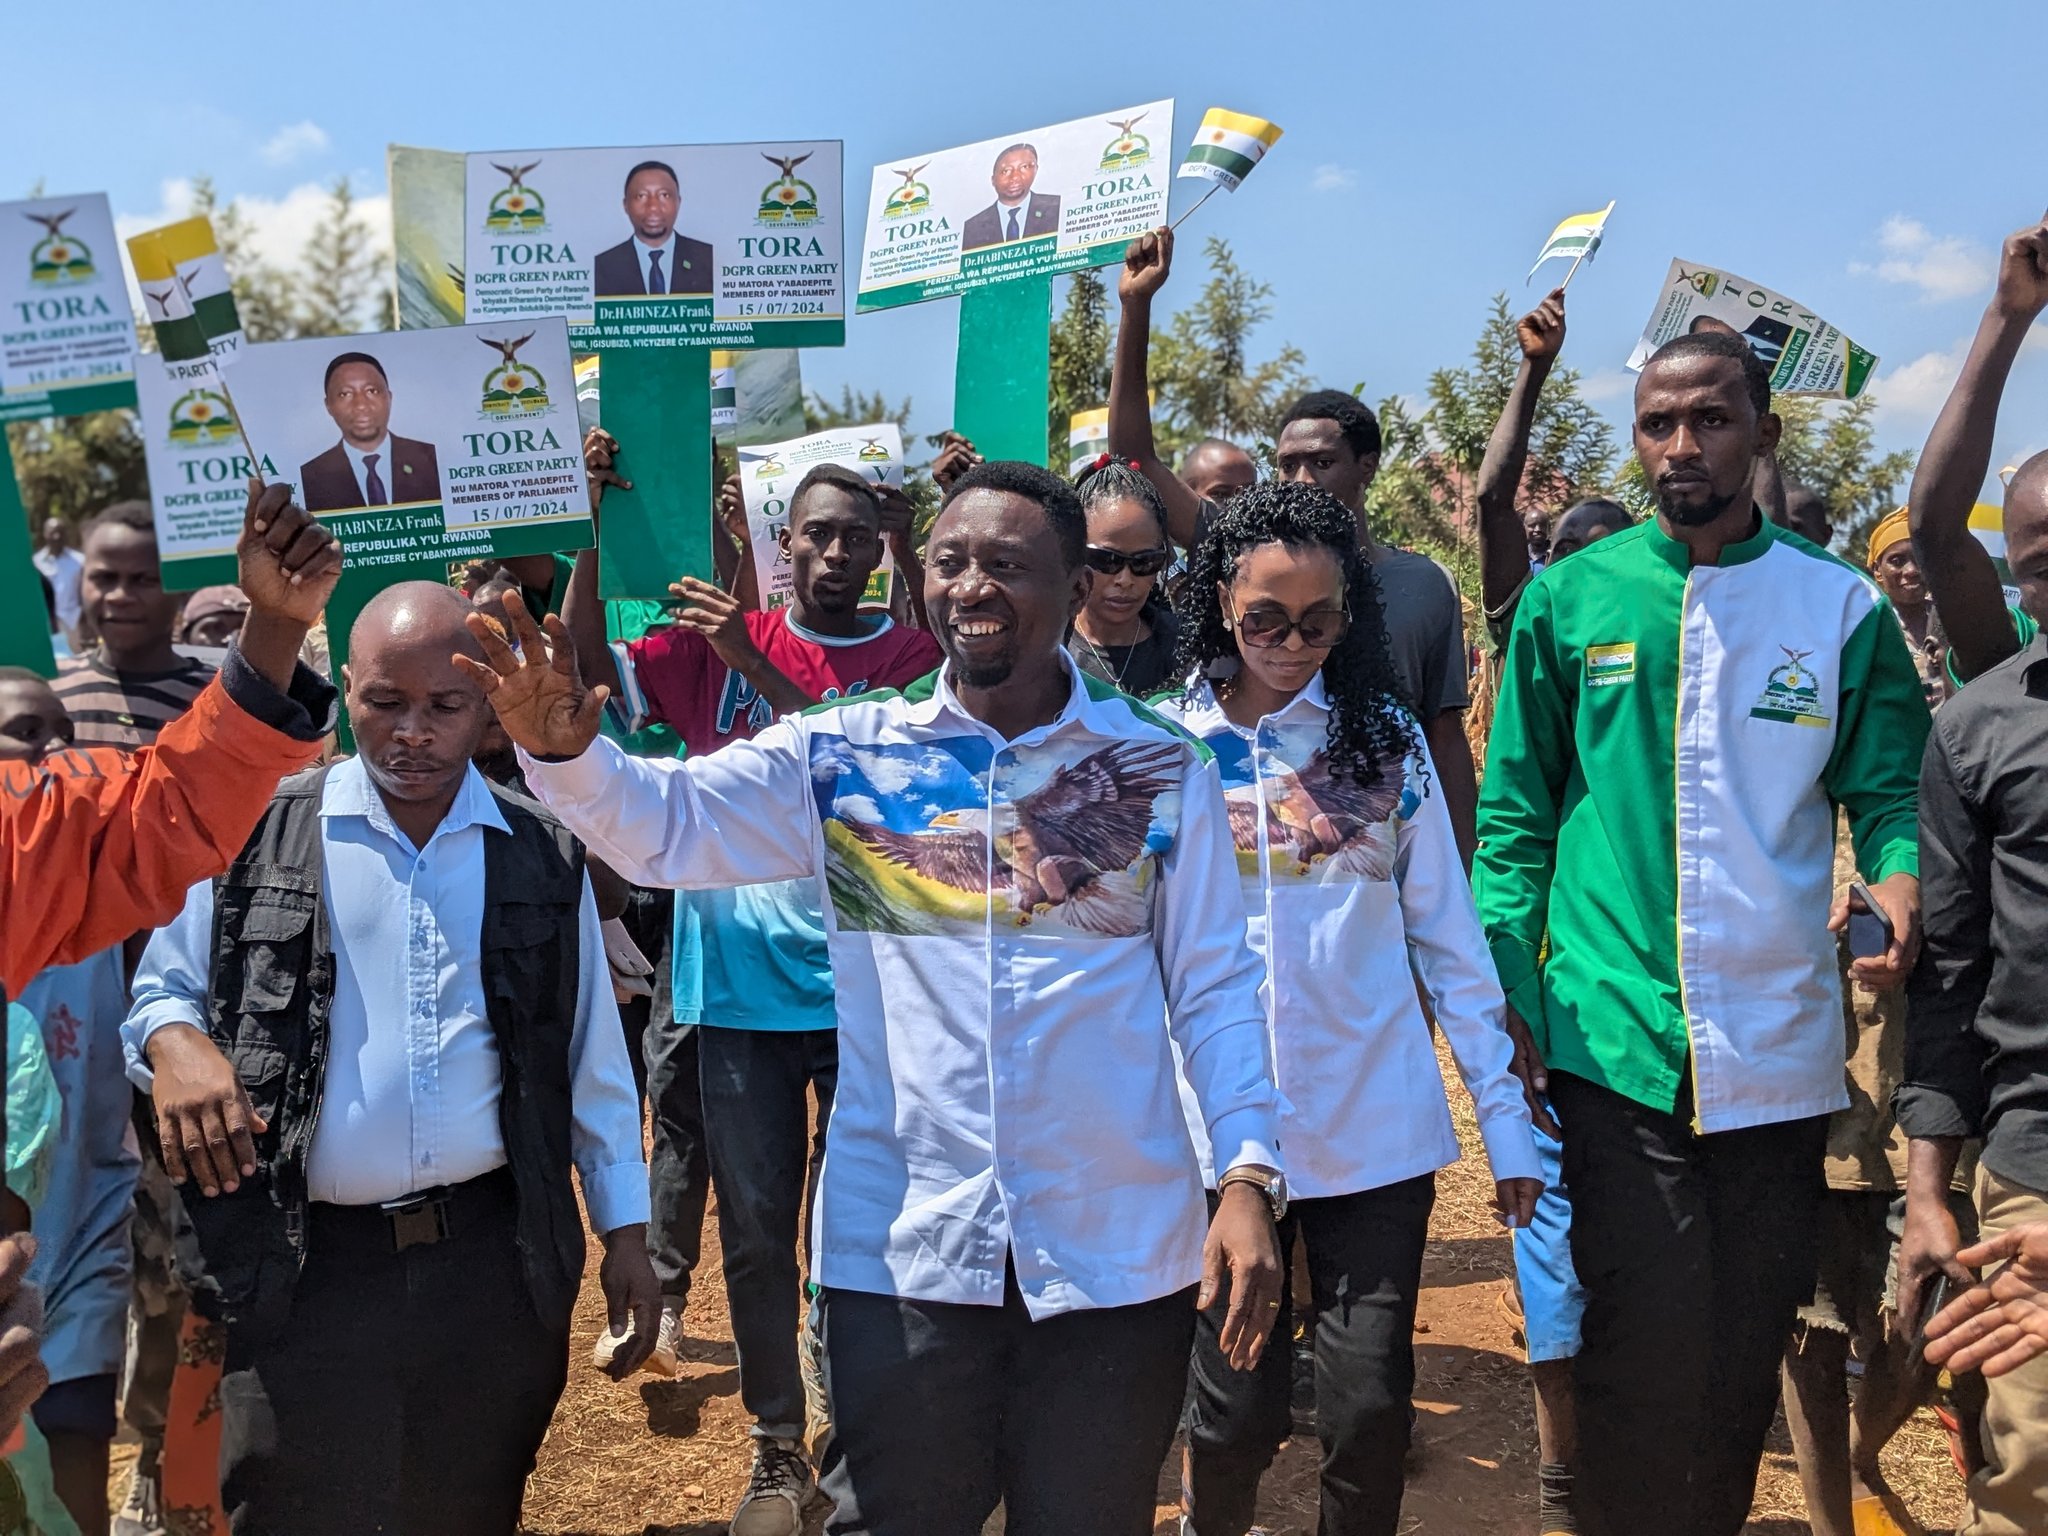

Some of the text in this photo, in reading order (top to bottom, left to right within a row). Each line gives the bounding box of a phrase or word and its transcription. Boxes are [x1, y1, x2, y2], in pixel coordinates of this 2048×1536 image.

[1188, 165, 1207, 173] DGPR
[1082, 173, 1152, 201] TORA
[1066, 190, 1164, 218] DGPR GREEN PARTY
[1065, 222, 1101, 234] MEMBERS
[1114, 209, 1160, 224] PARLIAMENT
[1066, 203, 1158, 227] MU MATORA Y'ABADEPITE
[885, 216, 950, 242] TORA
[1078, 233, 1091, 244] 15
[1122, 221, 1150, 236] 2024
[491, 243, 577, 265] TORA
[738, 236, 824, 258] TORA
[870, 233, 960, 259] DGPR GREEN PARTY
[870, 258, 898, 267] Democratic
[916, 251, 930, 260] Party
[938, 244, 959, 252] Rwanda
[964, 241, 1055, 268] Dr.HABINEZA Frank
[722, 263, 838, 276] DGPR GREEN PARTY
[925, 248, 1089, 287] PEREZIDA WA REPUBULIKA Y'U RWANDA
[938, 256, 960, 265] Rwanda
[475, 270, 590, 284] DGPR GREEN PARTY
[739, 280, 774, 288] MATORA
[776, 279, 832, 287] Y'ABADEPITE
[922, 284, 952, 297] URUMURI,
[954, 277, 988, 291] IGISUBIZO,
[475, 285, 590, 297] Democratic Green Party of Rwanda
[781, 289, 836, 297] PARLIAMENT
[13, 294, 110, 323] TORA
[566, 303, 593, 311] Rwanda
[600, 304, 711, 320] Dr.HABINEZA Frank
[740, 304, 754, 315] 15
[791, 302, 824, 314] 2024
[41, 325, 86, 340] GREEN
[89, 321, 128, 335] PARTY
[604, 325, 620, 335] WA
[623, 322, 687, 335] REPUBULIKA
[689, 323, 707, 333] Y'U
[710, 321, 753, 332] RWANDA
[678, 335, 755, 347] CY'ABANYARWANDA
[177, 358, 219, 379] PARTY
[1804, 349, 1831, 387] GREEN
[1826, 361, 1846, 391] ARLIAMENT
[495, 412, 540, 420] DEVELOPMENT
[712, 410, 735, 418] ARTY
[463, 427, 562, 457] TORA
[178, 453, 280, 484] TORA
[448, 456, 578, 480] DGPR GREEN PARTY
[451, 474, 574, 494] MU MATORA Y'ABADEPITE
[453, 485, 579, 504] MEMBERS OF PARLIAMENT
[164, 493, 202, 507] DGPR
[472, 508, 490, 522] 15
[532, 501, 568, 517] 2024
[329, 513, 443, 537] HABINEZA Frank
[344, 529, 492, 553] REPUBULIKA Y'U RWANDA
[358, 553, 407, 567] N'ICYIZERE
[409, 544, 494, 562] CY'ABANYARWANDA
[772, 573, 792, 582] PEREZ
[2003, 588, 2021, 599] ARTY
[1770, 702, 1810, 713] DEVELOPMENT
